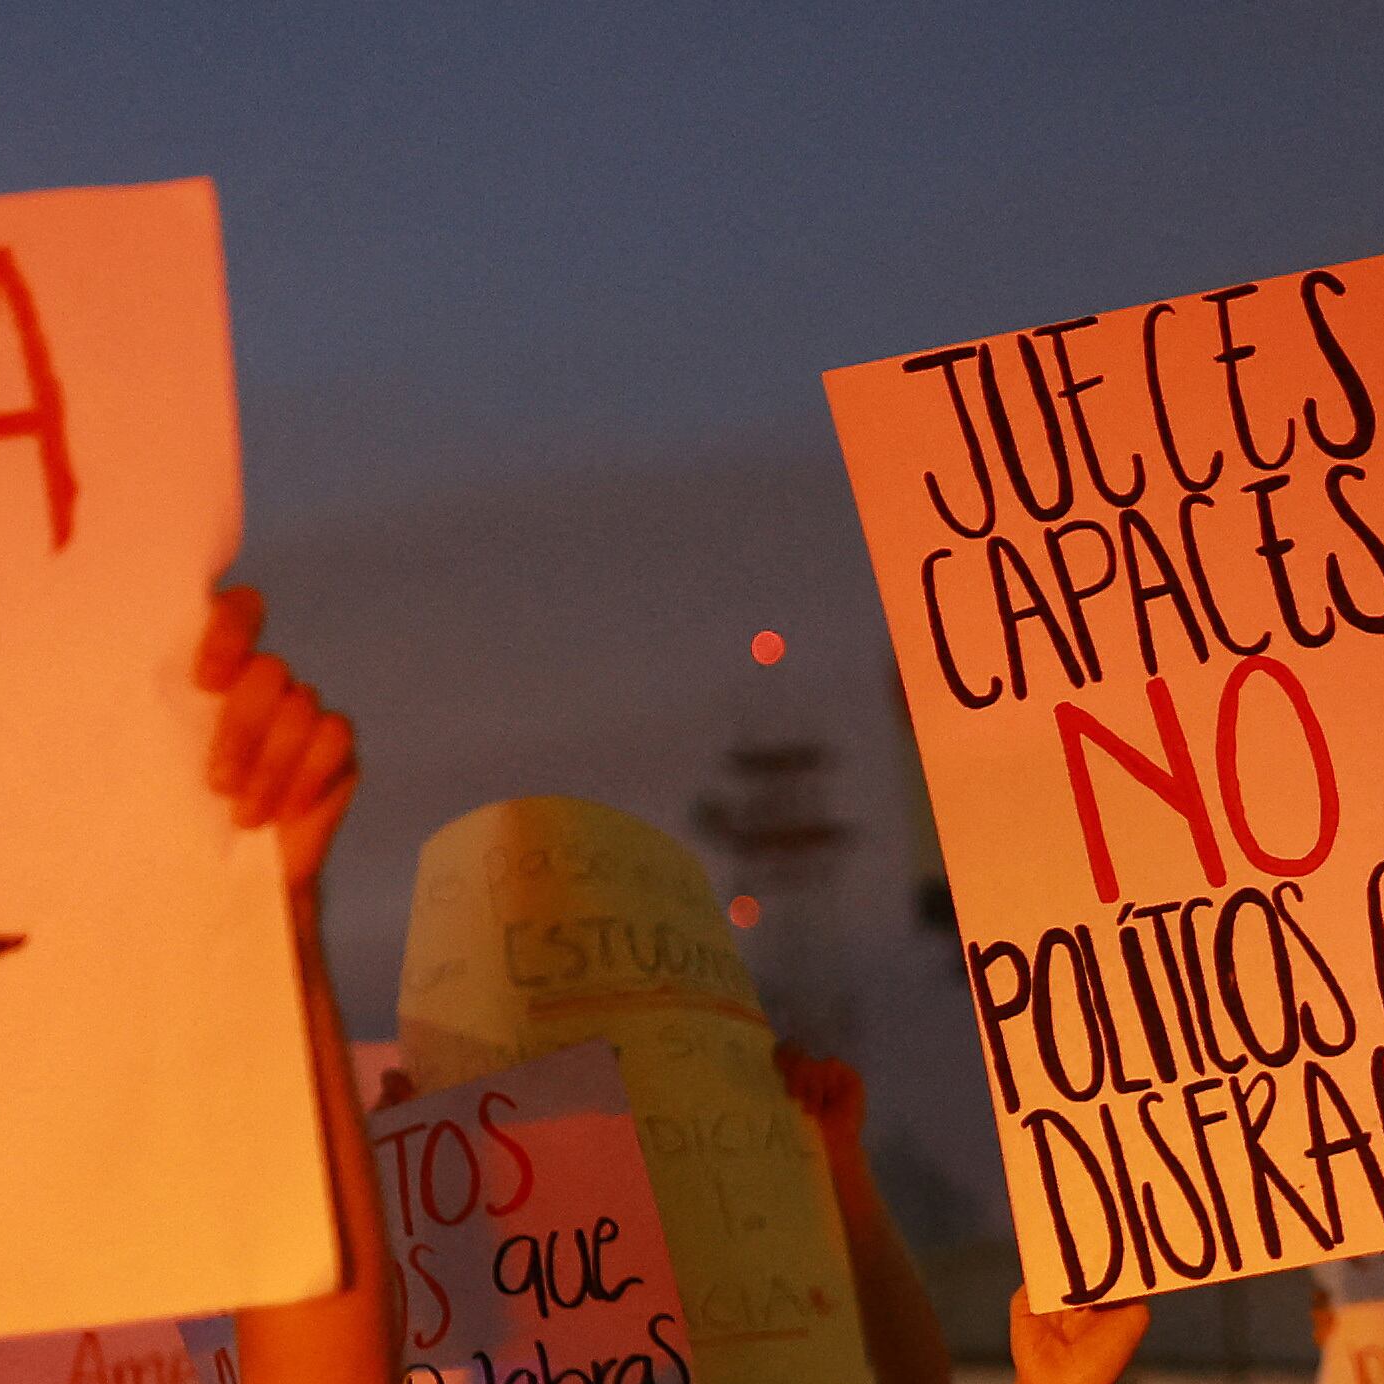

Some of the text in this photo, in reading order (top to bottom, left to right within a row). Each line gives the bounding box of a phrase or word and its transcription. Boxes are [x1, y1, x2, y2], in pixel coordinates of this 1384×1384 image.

[903, 269, 1376, 539] JUECES
[1055, 655, 1341, 904] NO
[492, 1216, 645, 1318] que
